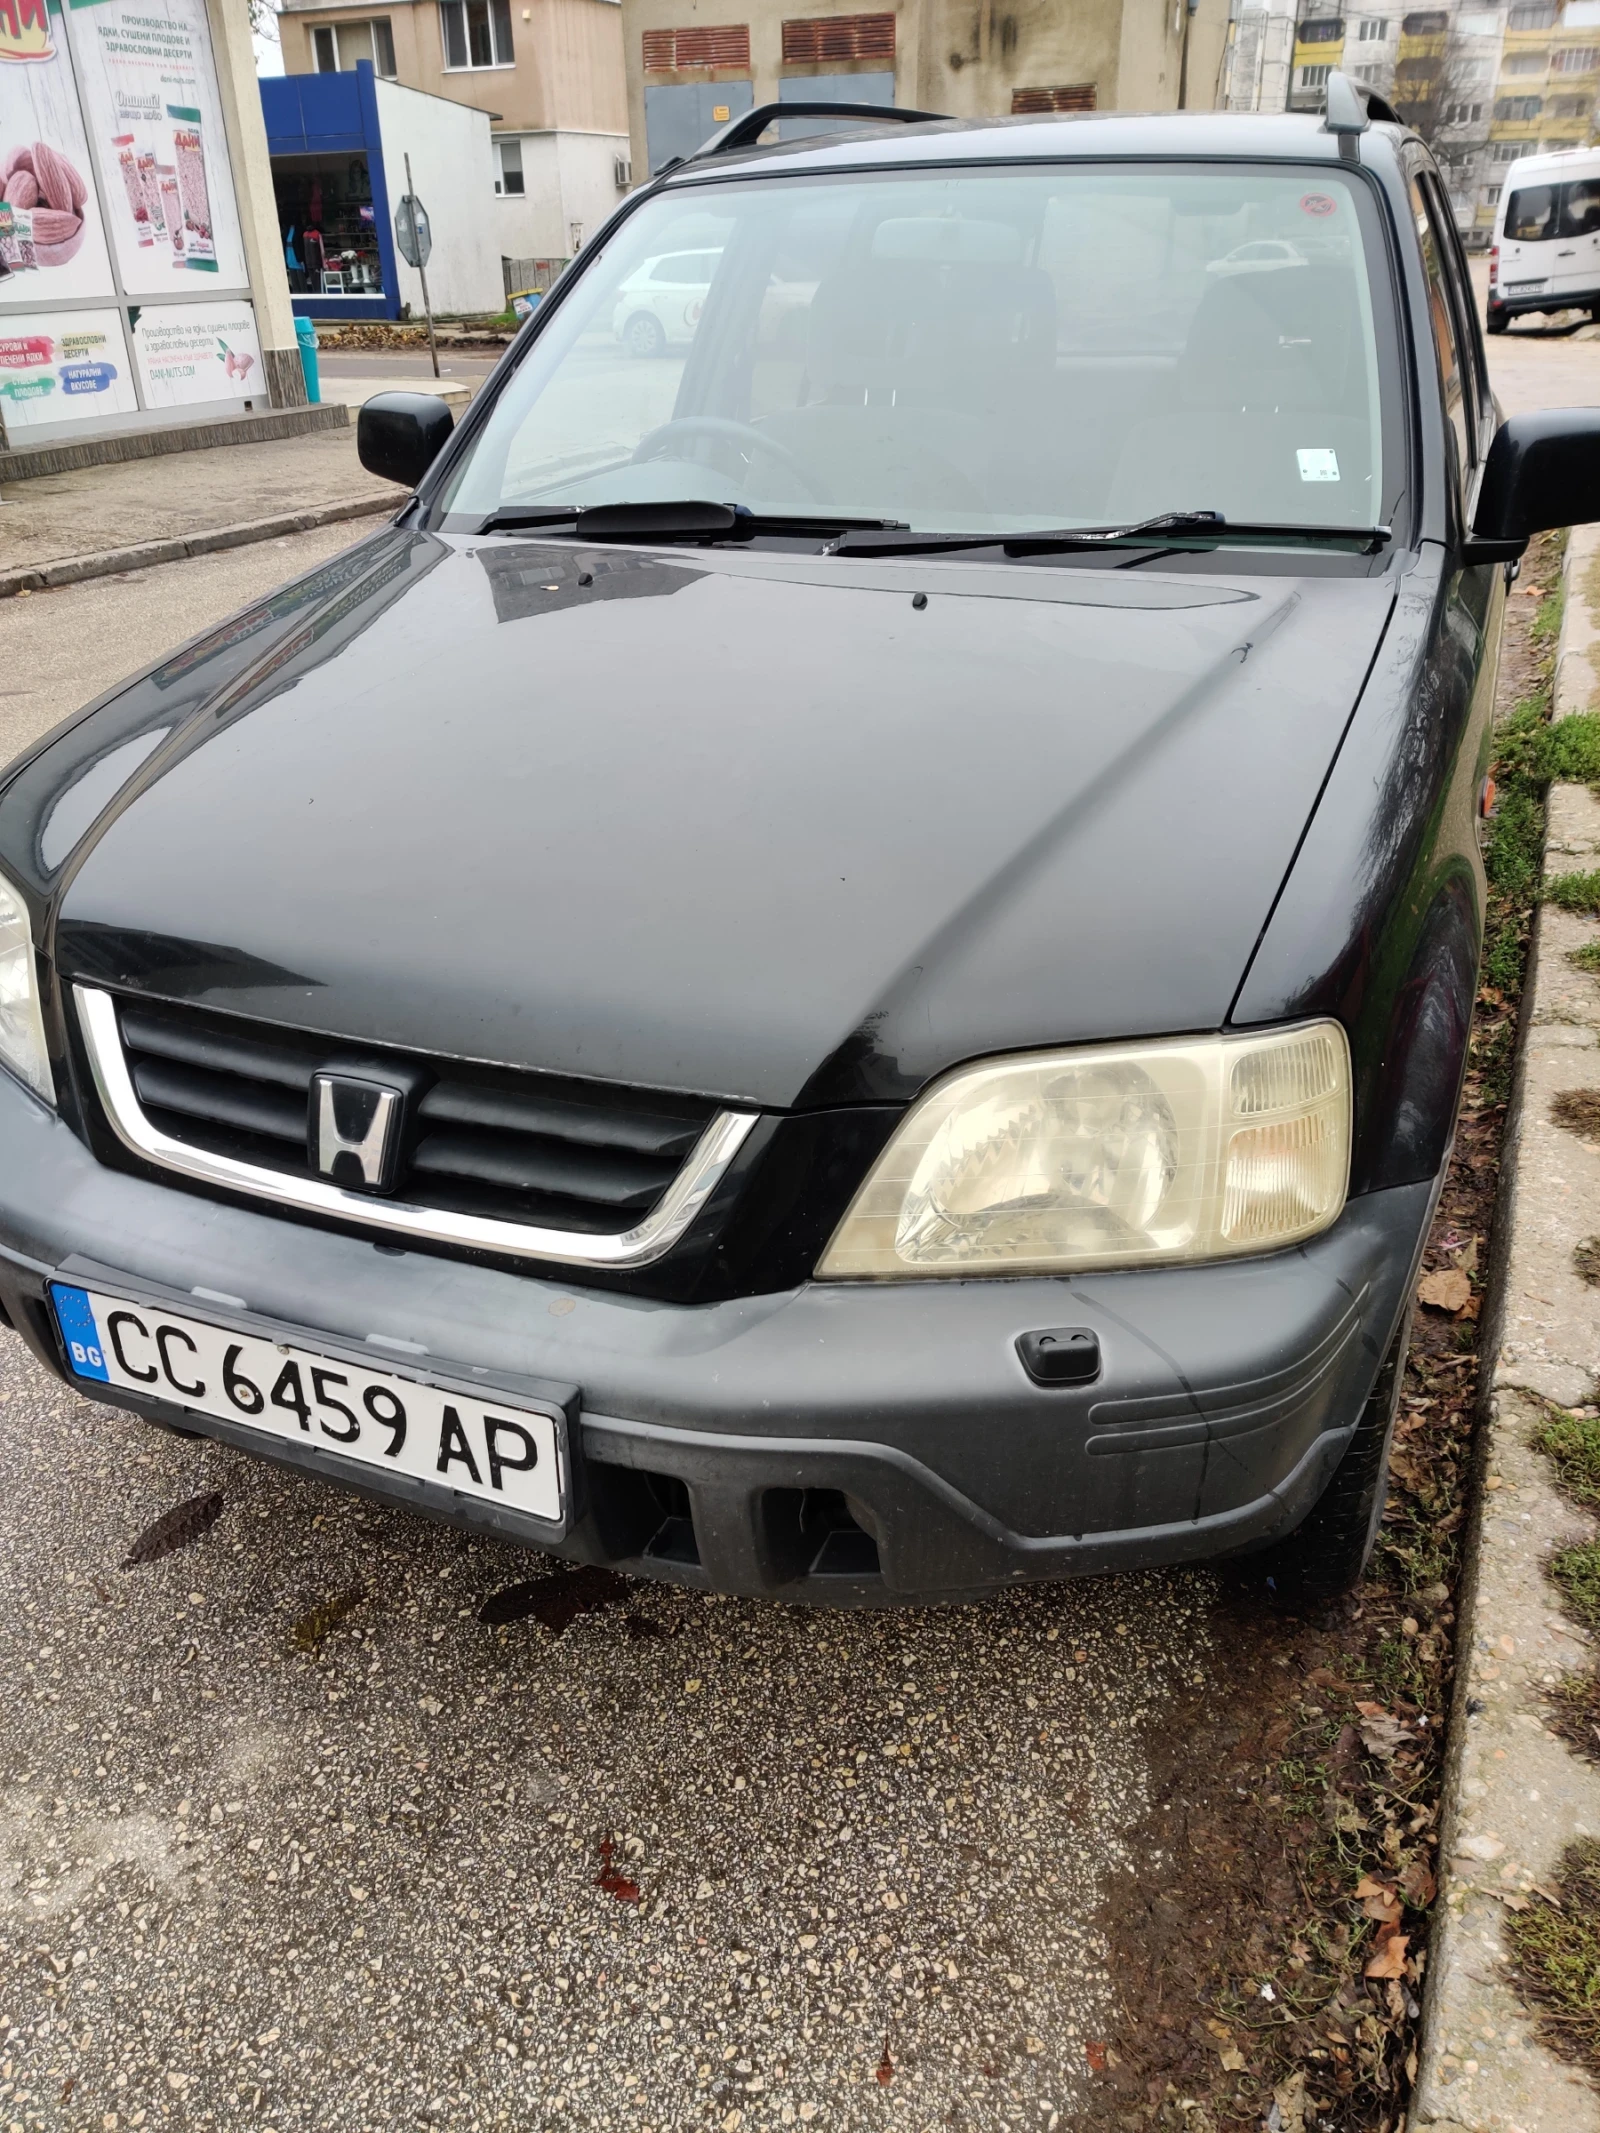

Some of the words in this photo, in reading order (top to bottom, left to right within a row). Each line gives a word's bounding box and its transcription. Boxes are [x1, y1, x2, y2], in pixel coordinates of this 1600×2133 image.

[122, 15, 177, 30] ПРОИЗВОДСТВО
[178, 23, 188, 31] НА
[121, 29, 150, 41] СУШЕНИ
[152, 33, 184, 45] ПЛОДОВЕ
[185, 37, 190, 45] И
[106, 41, 162, 57] ЗДРАВОСЛОВНИ
[164, 48, 192, 59] ДЕСЕРТИ
[160, 74, 196, 84] dani-nuts.com
[142, 325, 185, 339] Производство
[185, 326, 192, 334] на
[207, 323, 227, 334] сушени
[228, 320, 250, 333] плодове
[61, 335, 107, 347] ЗДРАВОСЛОВНИ
[150, 339, 189, 353] здравословни
[189, 337, 214, 349] десерти
[26, 352, 44, 363] ЯДКИ
[64, 348, 90, 359] ДЕСЕРТИ
[68, 368, 102, 379] НАТУРАЛНИ
[150, 365, 195, 380] DANI-NUTS.COM
[15, 386, 44, 397] ПЛОДОВЕ
[71, 380, 97, 391] ВКУСОВЕ
[71, 1340, 102, 1368] BG
[106, 1310, 207, 1398] CC
[222, 1344, 408, 1458] 6459
[436, 1405, 539, 1491] AP
